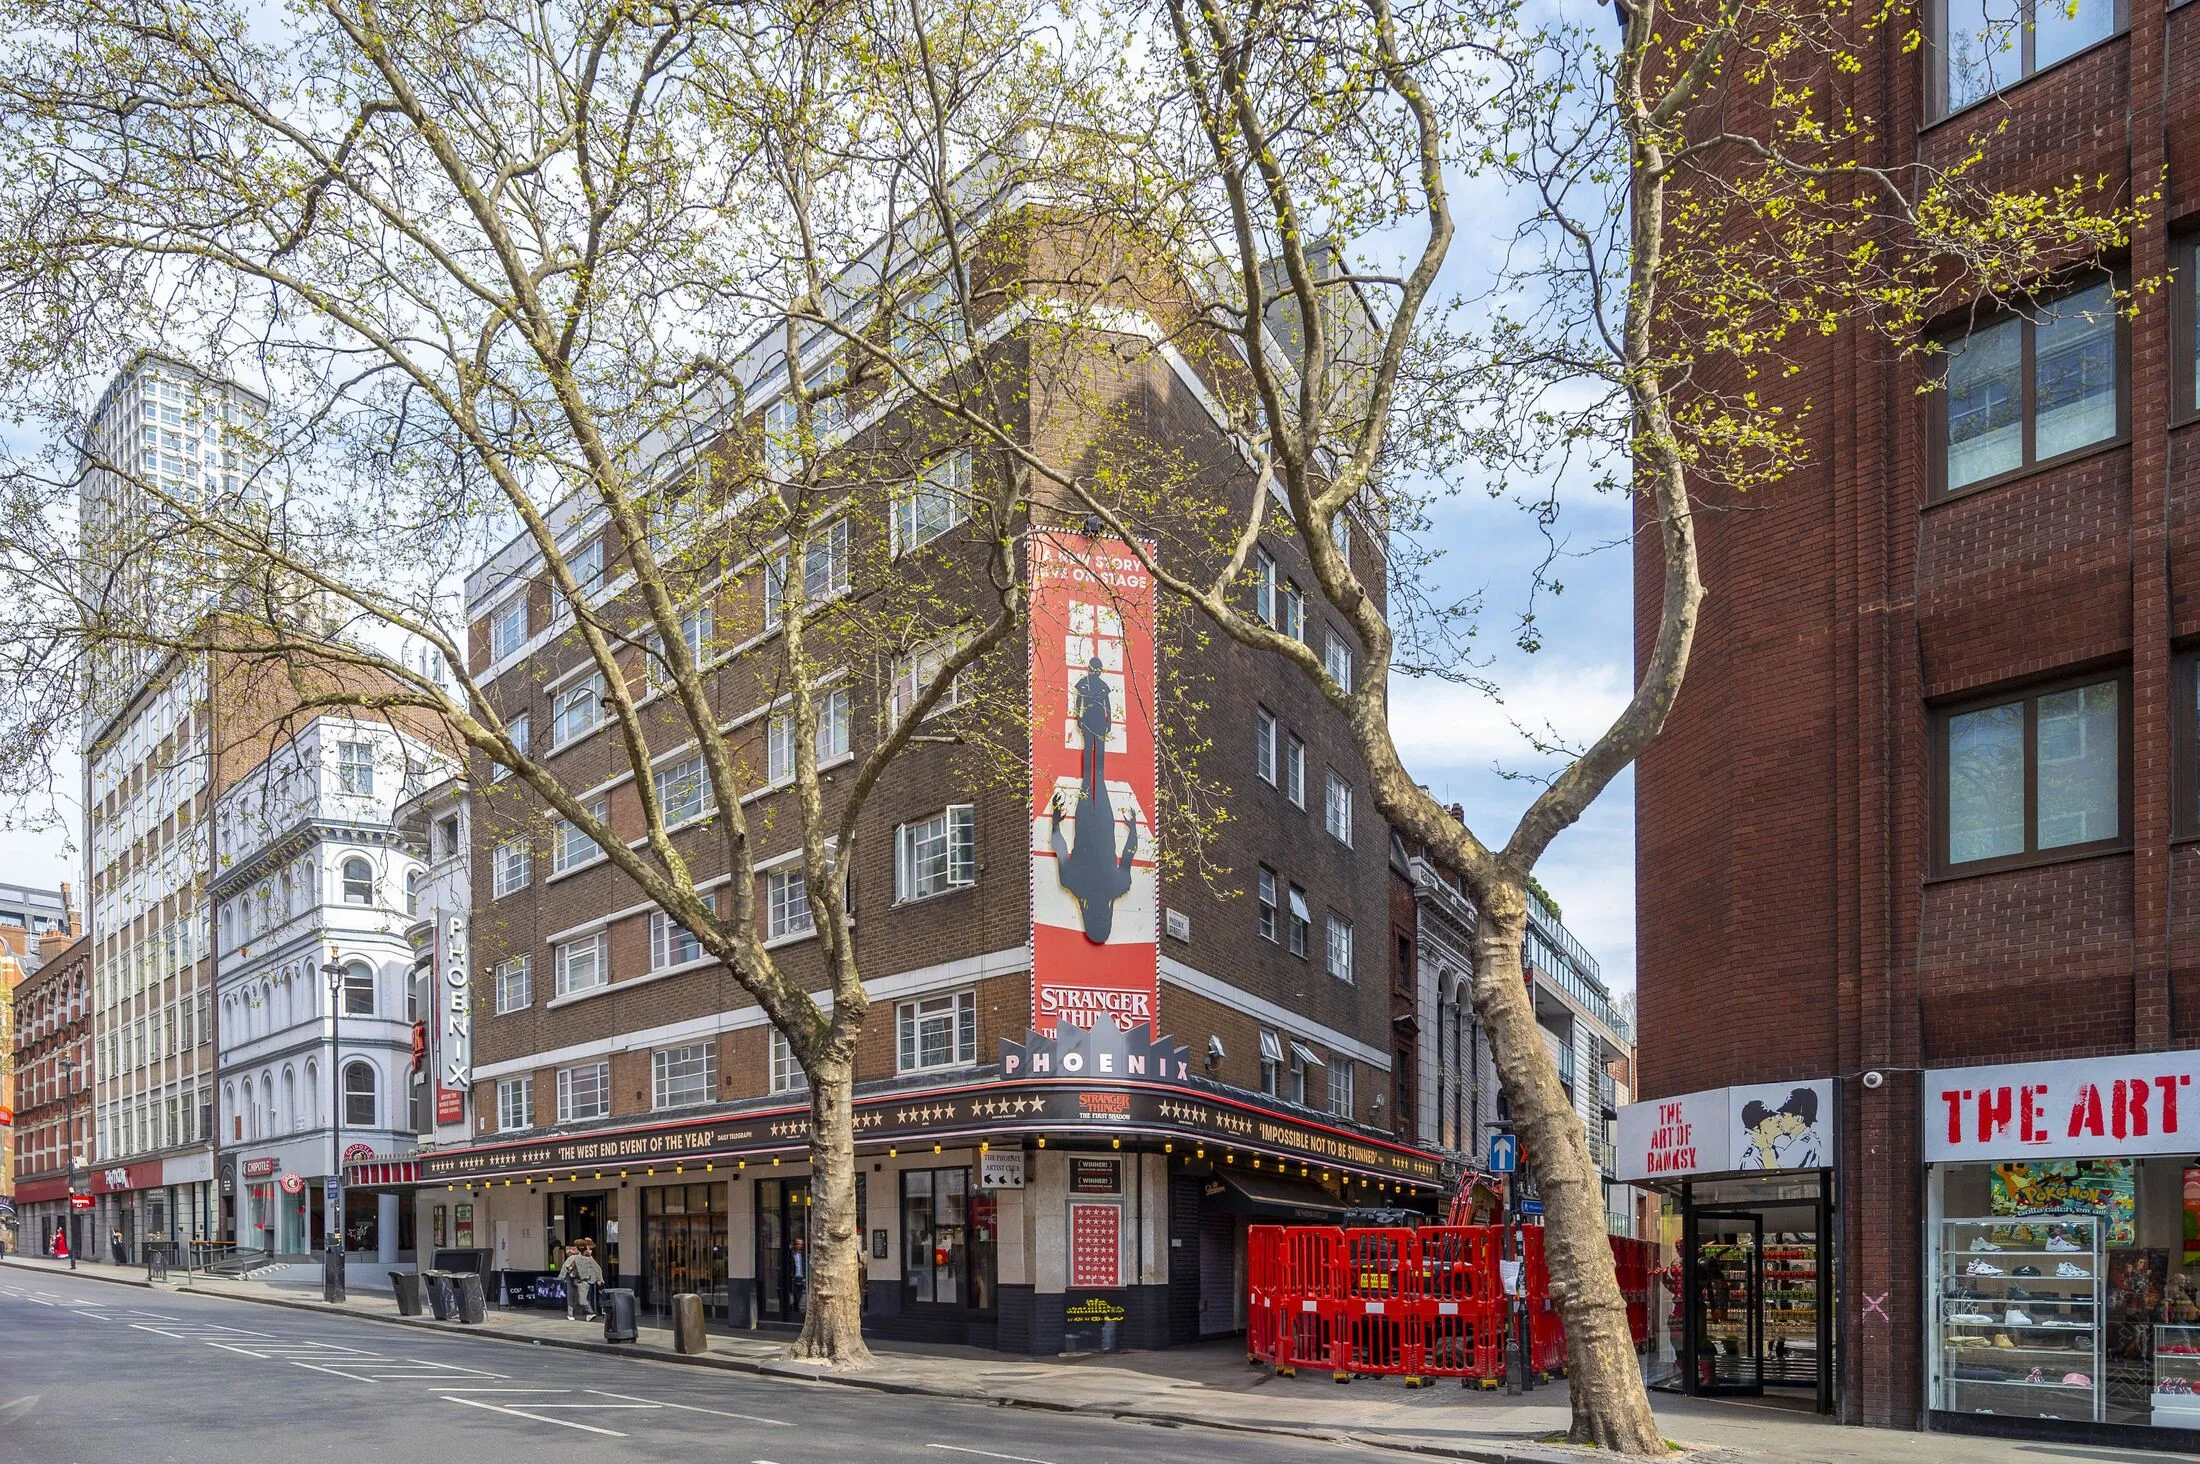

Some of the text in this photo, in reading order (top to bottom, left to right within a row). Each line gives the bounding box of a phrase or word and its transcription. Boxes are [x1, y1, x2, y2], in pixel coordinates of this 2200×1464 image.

[1044, 549, 1054, 562] A
[1095, 555, 1142, 572] STORY
[1072, 567, 1097, 583] ON
[1100, 571, 1147, 589] STAGE
[446, 917, 467, 1088] PHOENIX
[1041, 988, 1151, 1017] STRANGER
[1058, 1009, 1134, 1030] THIGS
[1005, 1052, 1188, 1081] PHOENIX
[1079, 1093, 1130, 1107] STRANGER
[1088, 1104, 1123, 1114] THINGS
[1942, 1075, 2191, 1144] THE ART
[1659, 1101, 1682, 1125] THE
[576, 1144, 599, 1158] WEST
[600, 1142, 617, 1157] END
[620, 1140, 648, 1155] EVENT
[650, 1137, 663, 1151] OF
[665, 1135, 683, 1150] THE
[1259, 1123, 1309, 1150] 'IMPOSSIBLE
[1310, 1136, 1326, 1153] NOT
[1327, 1139, 1337, 1155] TO
[1338, 1142, 1347, 1158] BE
[1651, 1123, 1692, 1149] ART OF
[247, 1160, 270, 1172] CHIPOTLE
[986, 1163, 1005, 1171] ARTIST
[1647, 1147, 1697, 1174] BANKSY
